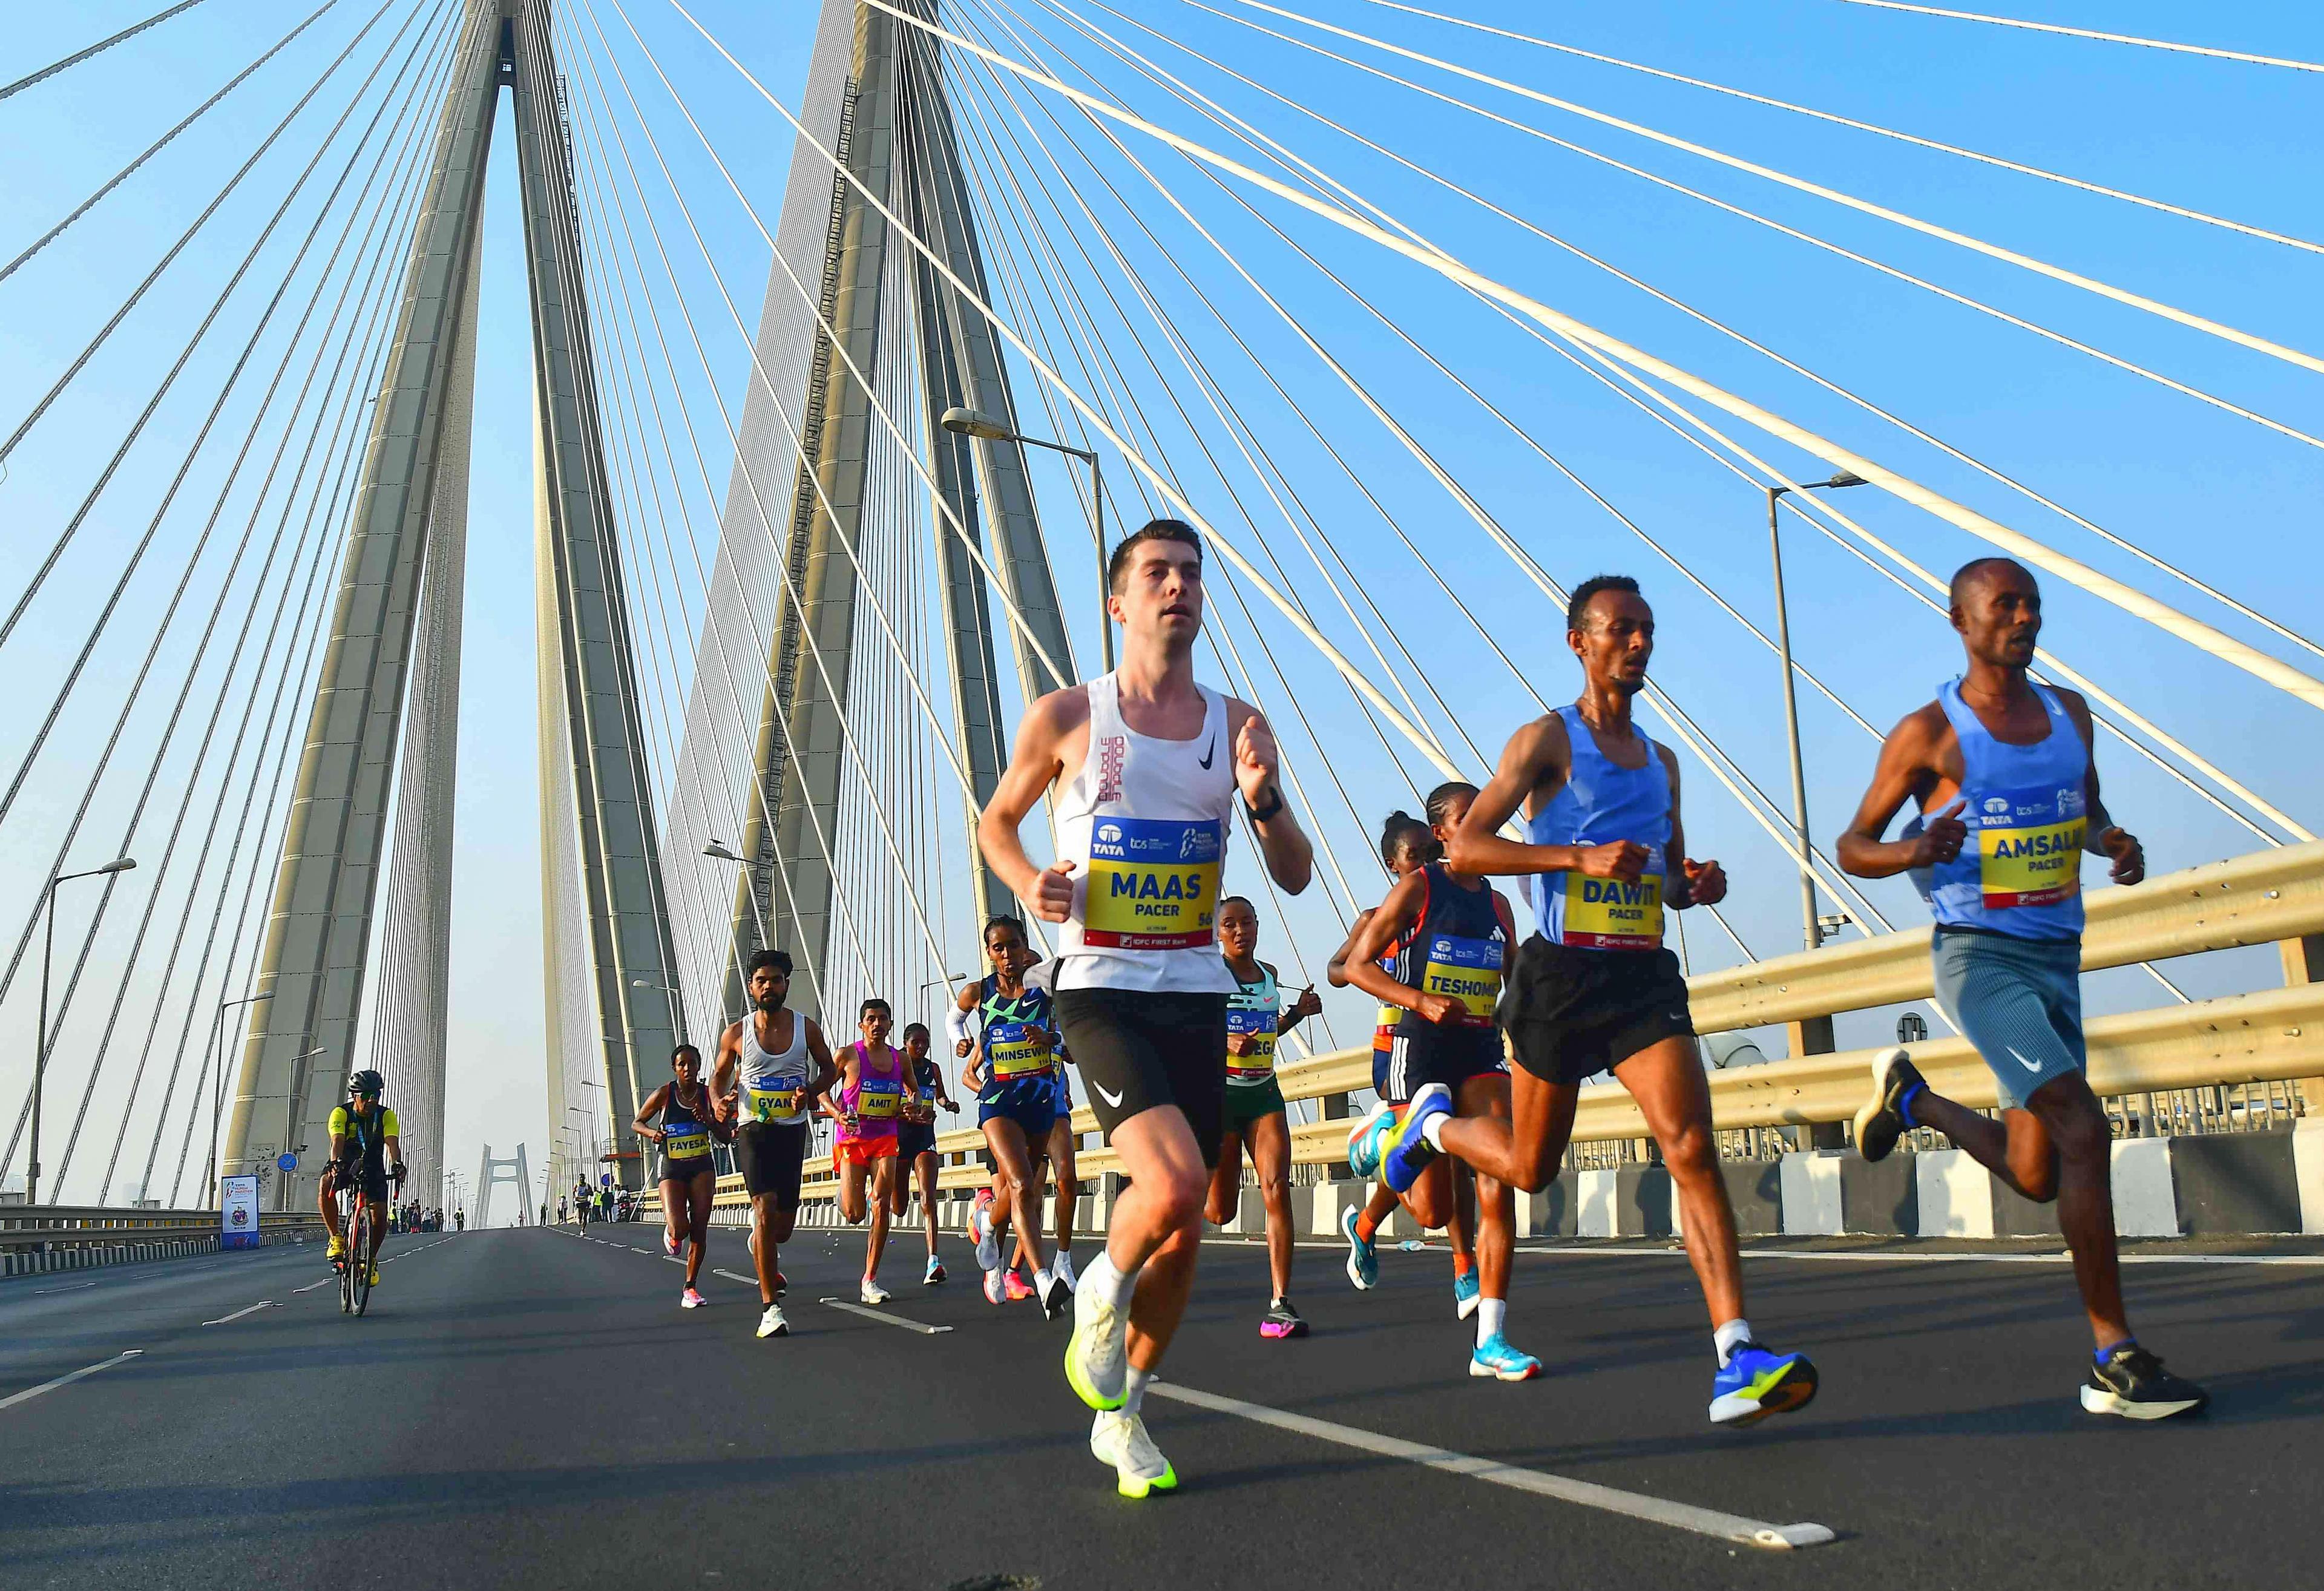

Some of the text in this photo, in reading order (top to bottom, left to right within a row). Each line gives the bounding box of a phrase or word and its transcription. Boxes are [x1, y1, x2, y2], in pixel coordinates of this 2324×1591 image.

[1980, 815, 2013, 825] TATA
[1092, 843, 1126, 857] TATA
[1130, 837, 1148, 850] tcs
[1111, 872, 1201, 900] MAAS
[1583, 880, 1655, 905] DAWIT
[1135, 904, 1180, 917] PACER
[1608, 909, 1644, 920] PACER
[1431, 951, 1452, 961] TATA
[758, 1097, 792, 1108] GYAN
[867, 1098, 891, 1108] AMIT
[669, 1138, 707, 1152] FAYESA
